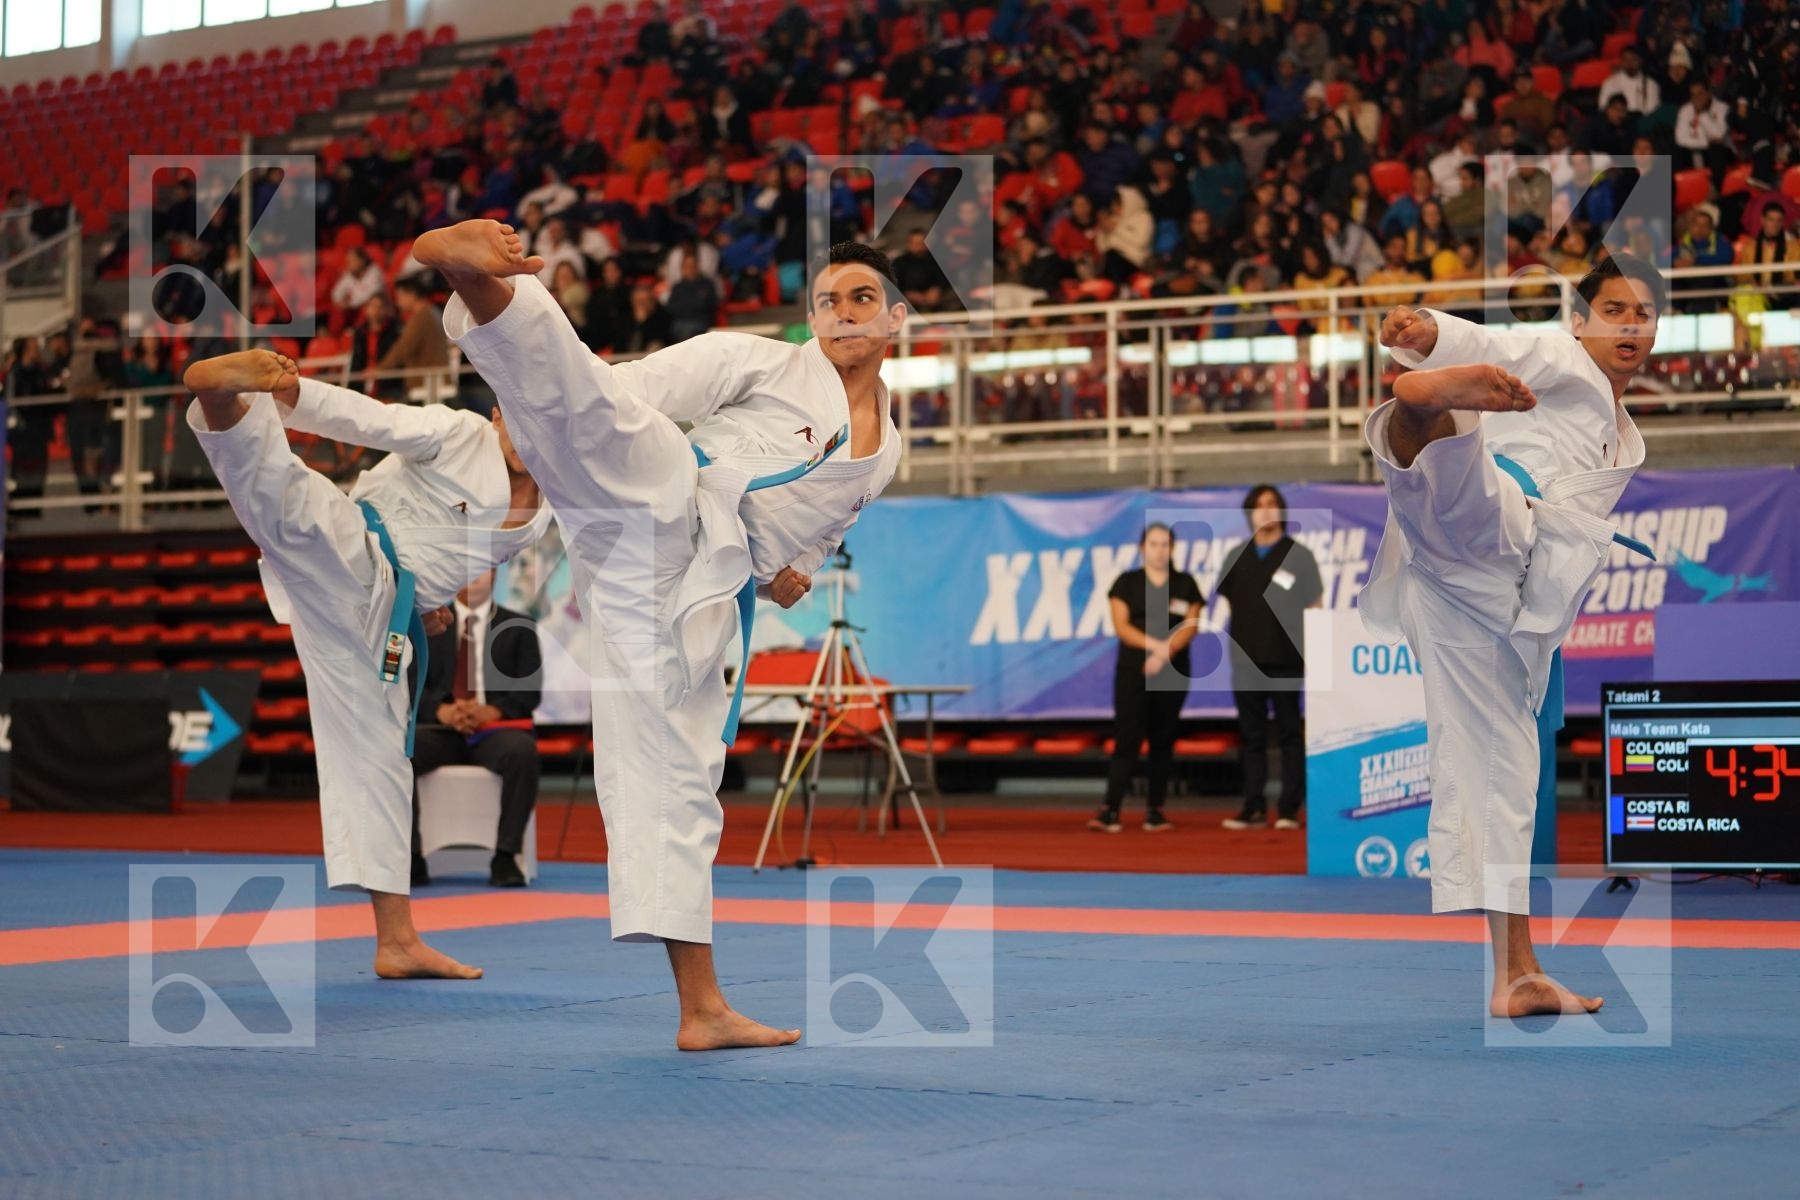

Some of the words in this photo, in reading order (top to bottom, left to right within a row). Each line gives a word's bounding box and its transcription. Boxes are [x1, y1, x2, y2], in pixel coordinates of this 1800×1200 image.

[1583, 567, 1668, 614] 2018
[1607, 690, 1650, 703] Tatami
[1652, 690, 1661, 703] 2
[1610, 723, 1640, 736] Male
[1643, 723, 1678, 735] Team
[1681, 722, 1711, 735] Kata
[1627, 801, 1674, 814] COSTA
[1657, 818, 1704, 831] COSTA
[1707, 818, 1740, 831] RICA
